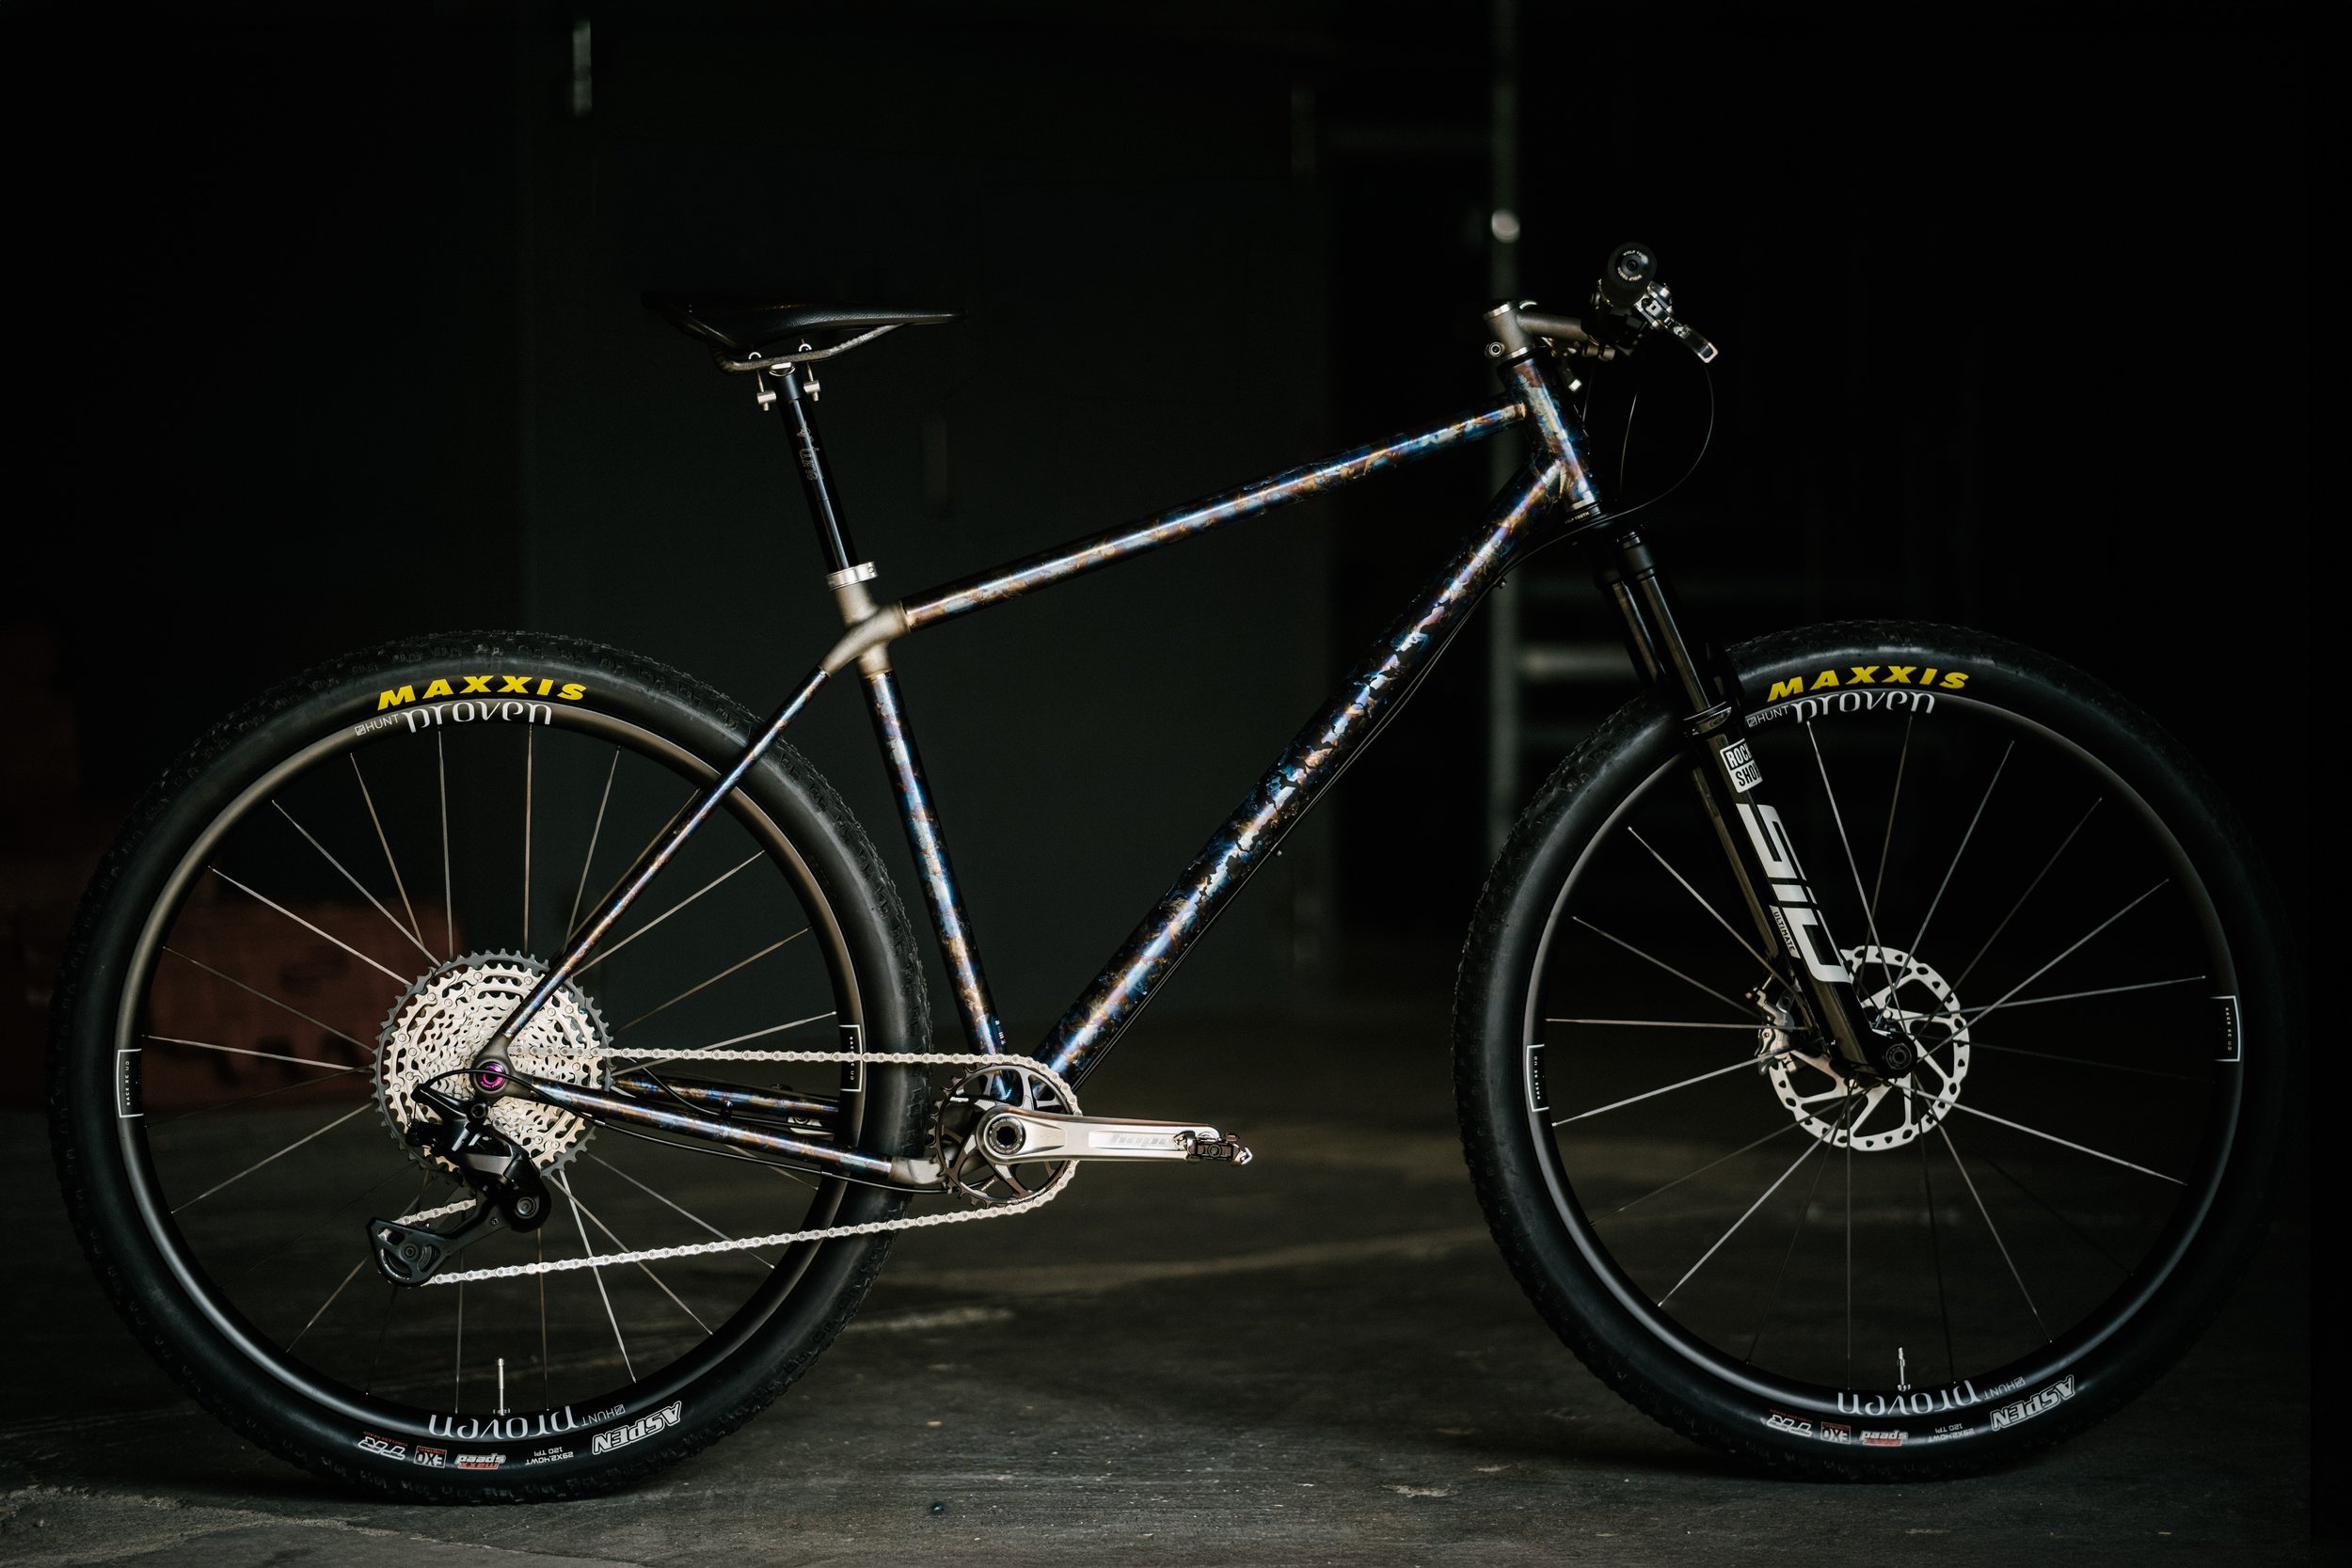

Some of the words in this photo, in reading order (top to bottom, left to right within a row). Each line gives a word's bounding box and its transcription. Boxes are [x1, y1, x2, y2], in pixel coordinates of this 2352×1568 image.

[377, 674, 587, 711] MAXXIS
[1767, 665, 1969, 703] MAXXIS
[366, 713, 399, 733] HUNT
[402, 701, 552, 734] proven
[1756, 706, 1788, 724] HUNT
[1790, 690, 1935, 724] proven
[1773, 911, 1796, 952] ULTIMATE
[1837, 1379, 1981, 1416] proven
[1980, 1379, 2016, 1401] HUNT
[1990, 1374, 2075, 1433] ASPEN
[429, 1405, 582, 1439] proven
[580, 1407, 615, 1428] HUNT
[591, 1401, 682, 1455] ASPEN
[1767, 1414, 1812, 1437] TR
[358, 1436, 405, 1461] TR
[1822, 1428, 1850, 1445] EXO
[1859, 1430, 1909, 1441] speed
[415, 1450, 446, 1467] EXO
[453, 1452, 506, 1465] speed
